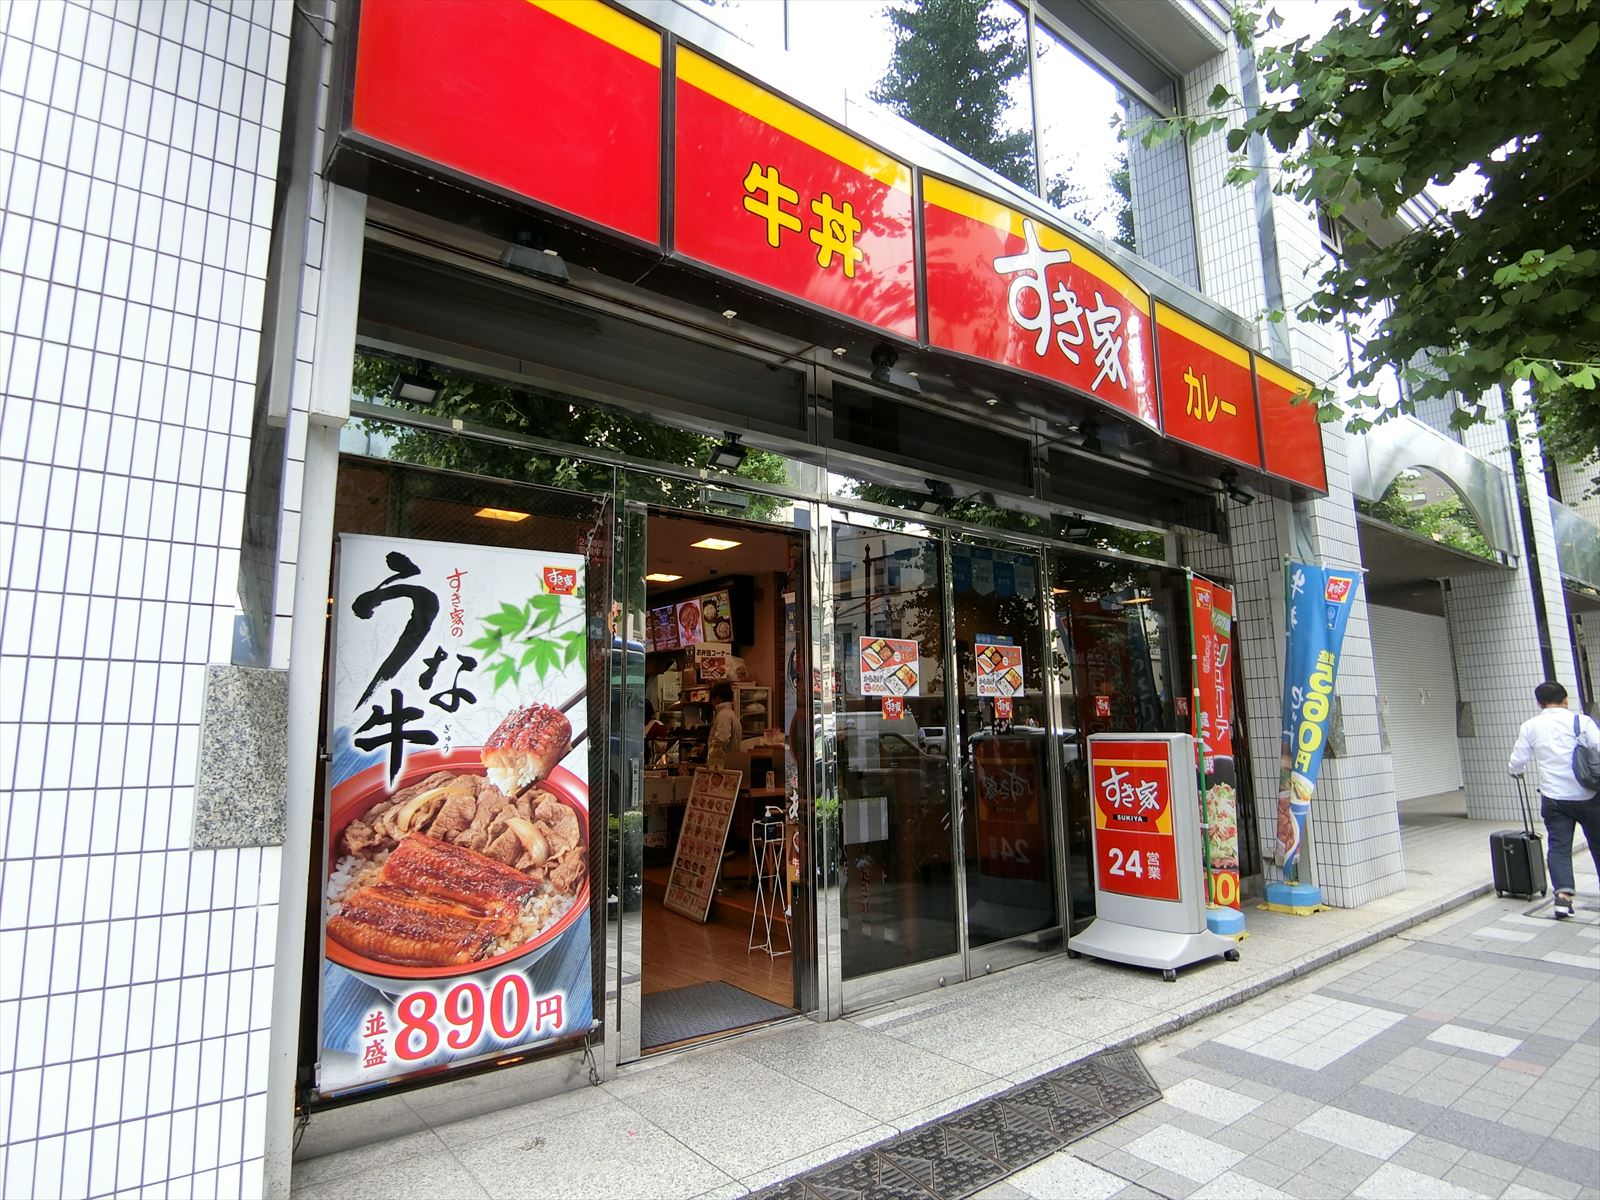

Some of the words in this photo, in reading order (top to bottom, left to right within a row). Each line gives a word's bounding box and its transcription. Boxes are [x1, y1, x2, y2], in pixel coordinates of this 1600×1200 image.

[743, 161, 863, 278] 牛丼
[993, 218, 1128, 392] すき家
[1183, 366, 1237, 424] カレー
[446, 567, 466, 638] すき家の
[548, 569, 573, 587] すき家
[443, 724, 452, 754] ぎゅう
[1102, 767, 1160, 814] すき家
[1117, 814, 1143, 822] SUKIYA
[1108, 847, 1143, 878] 24
[1147, 851, 1161, 880] 営業
[362, 1012, 388, 1068] 並盛
[394, 974, 564, 1062] 890円
